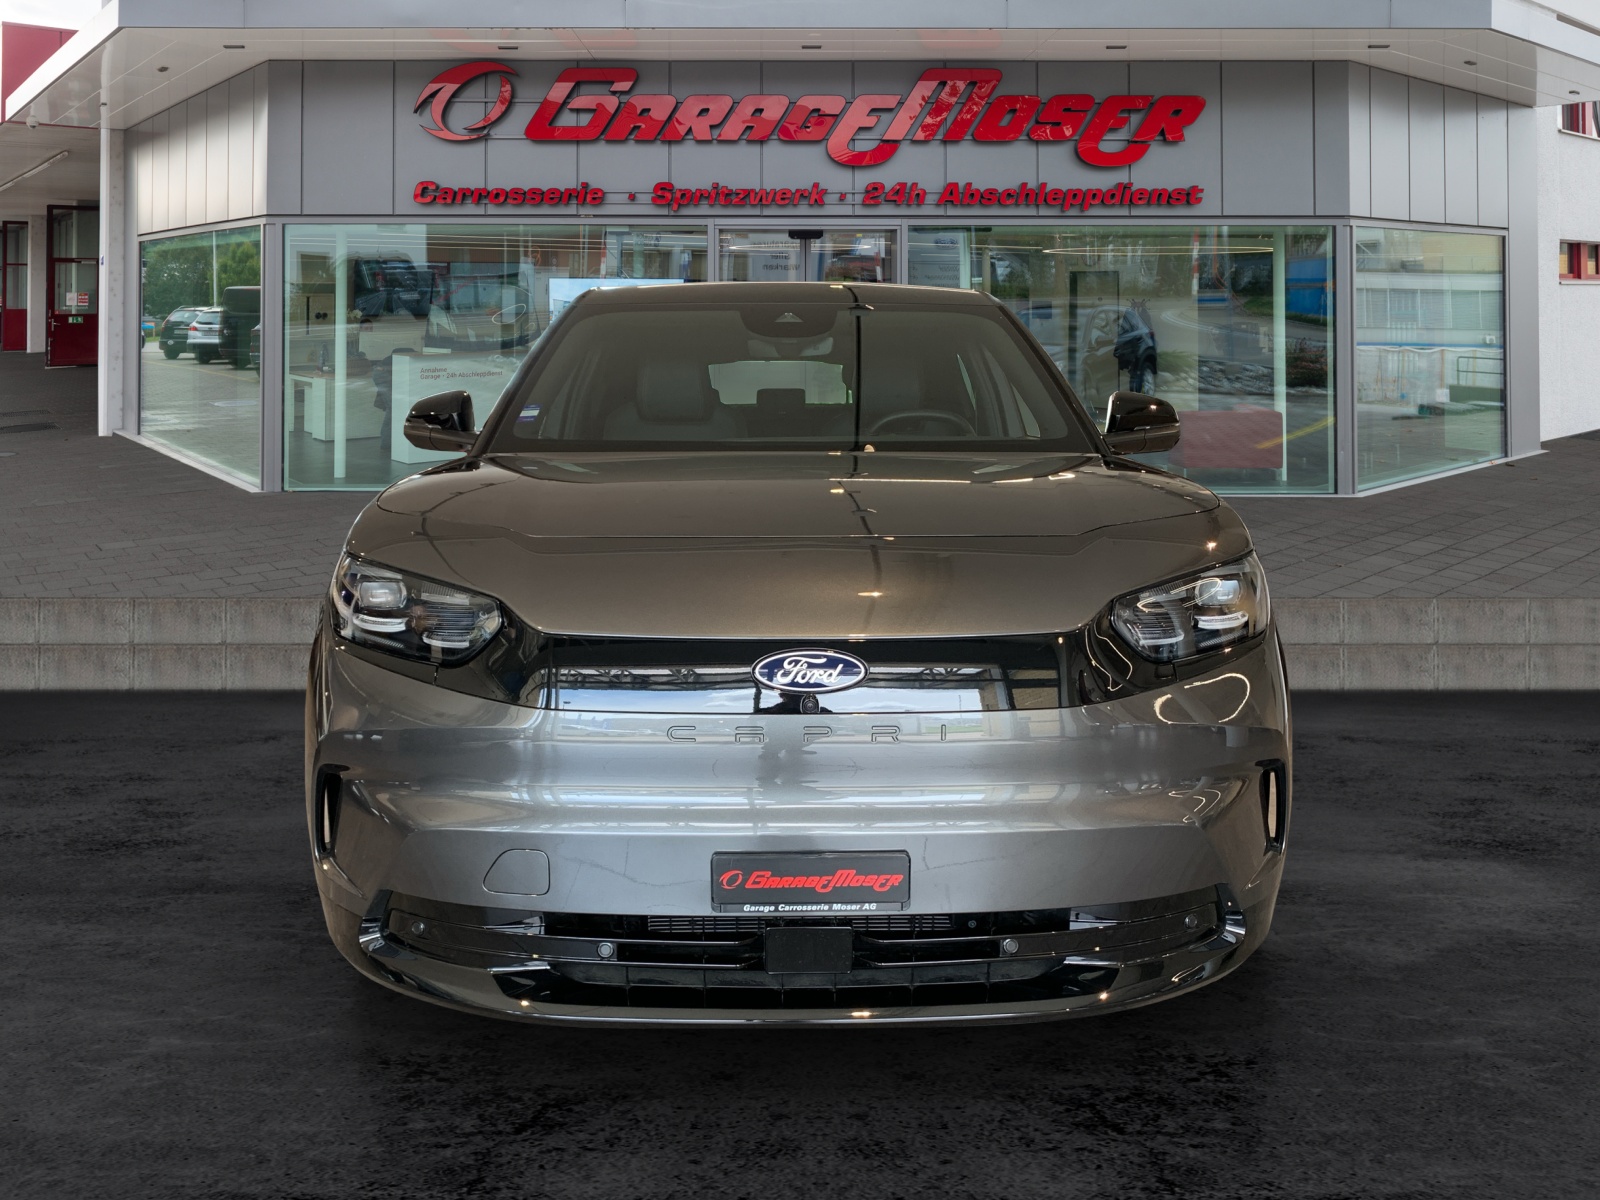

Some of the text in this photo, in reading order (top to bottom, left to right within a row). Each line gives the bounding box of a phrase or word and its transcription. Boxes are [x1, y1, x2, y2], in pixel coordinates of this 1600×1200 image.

[413, 181, 1204, 211] Carrosserie Spritzwerk 24h Abschleppdienst
[458, 371, 503, 379] Abschleppdienst
[776, 655, 843, 684] Ford
[666, 724, 947, 743] CAPRI
[743, 904, 775, 913] Garage
[778, 903, 829, 911] Carrosserie
[832, 903, 860, 911] Moser
